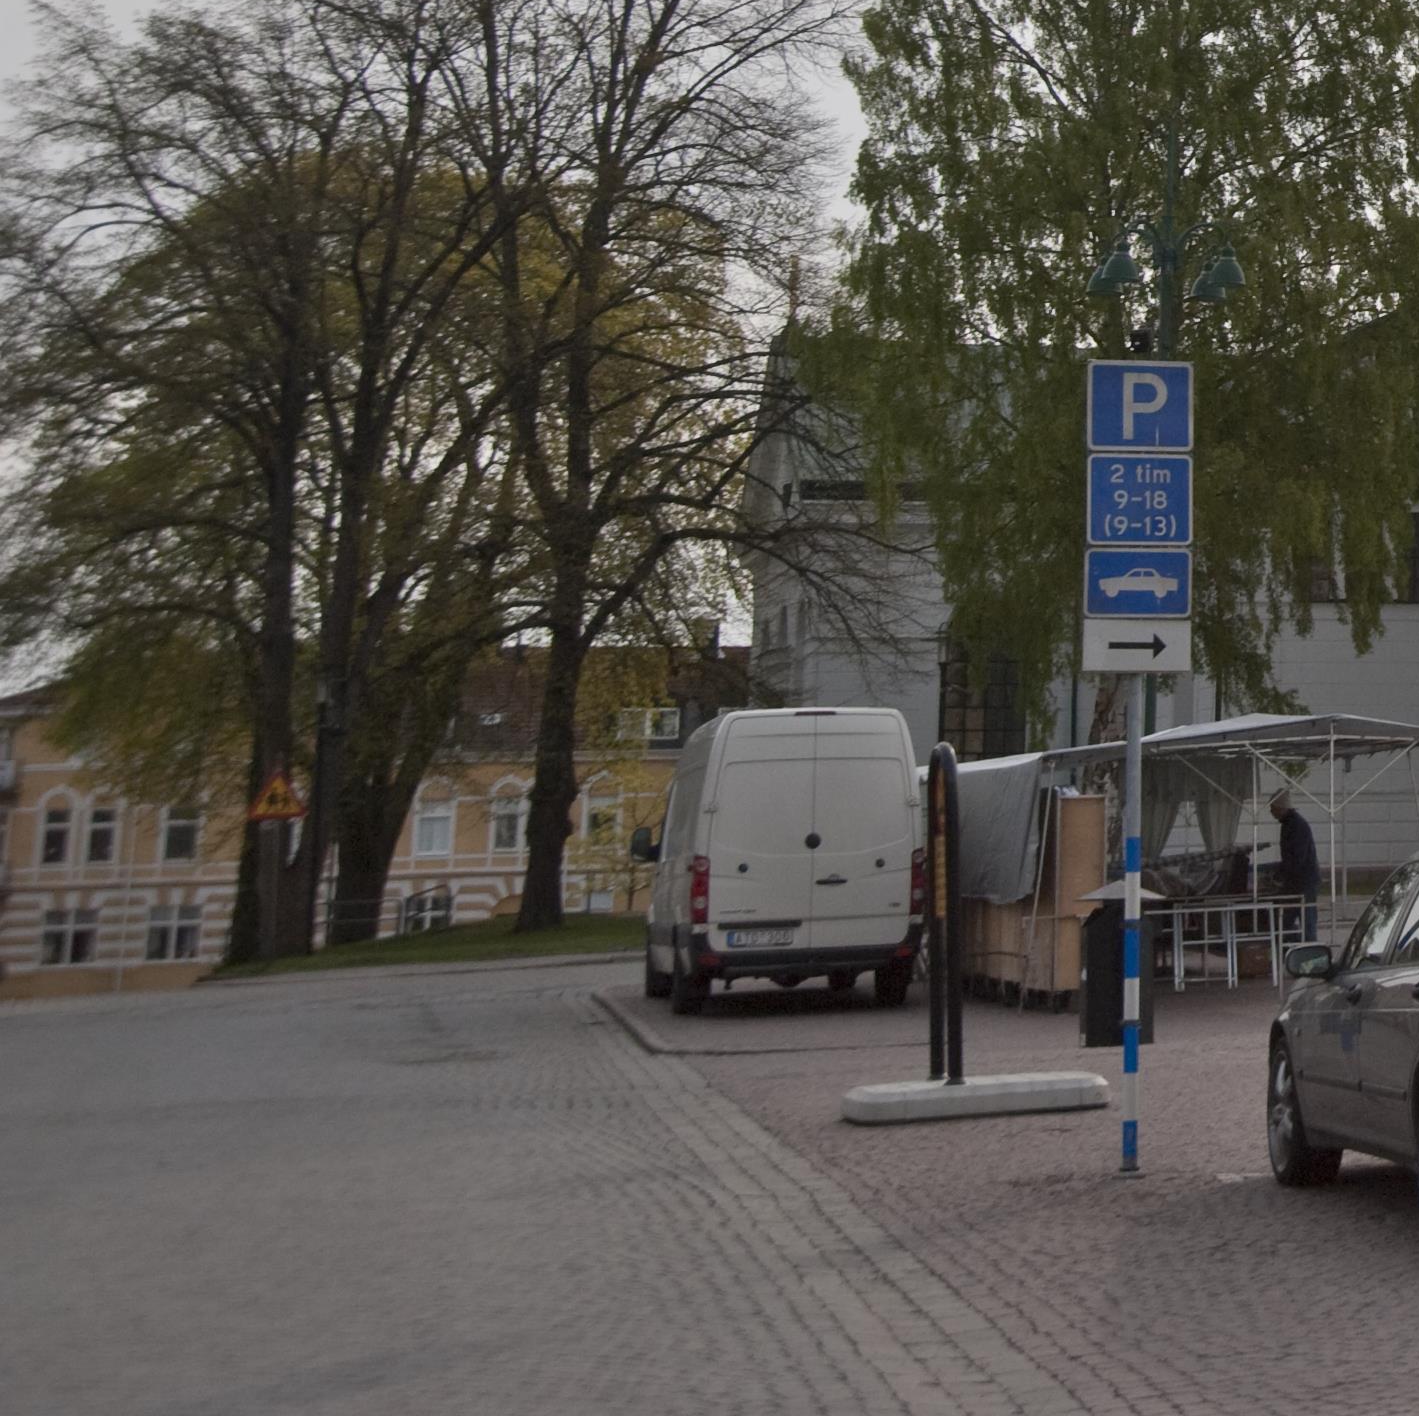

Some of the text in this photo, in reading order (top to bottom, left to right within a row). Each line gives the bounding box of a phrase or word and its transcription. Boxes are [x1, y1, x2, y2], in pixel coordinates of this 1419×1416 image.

[1122, 372, 1168, 440] P
[1109, 463, 1171, 484] 2 tim
[1113, 491, 1167, 510] 9-18
[1104, 514, 1177, 538] (9-13)
